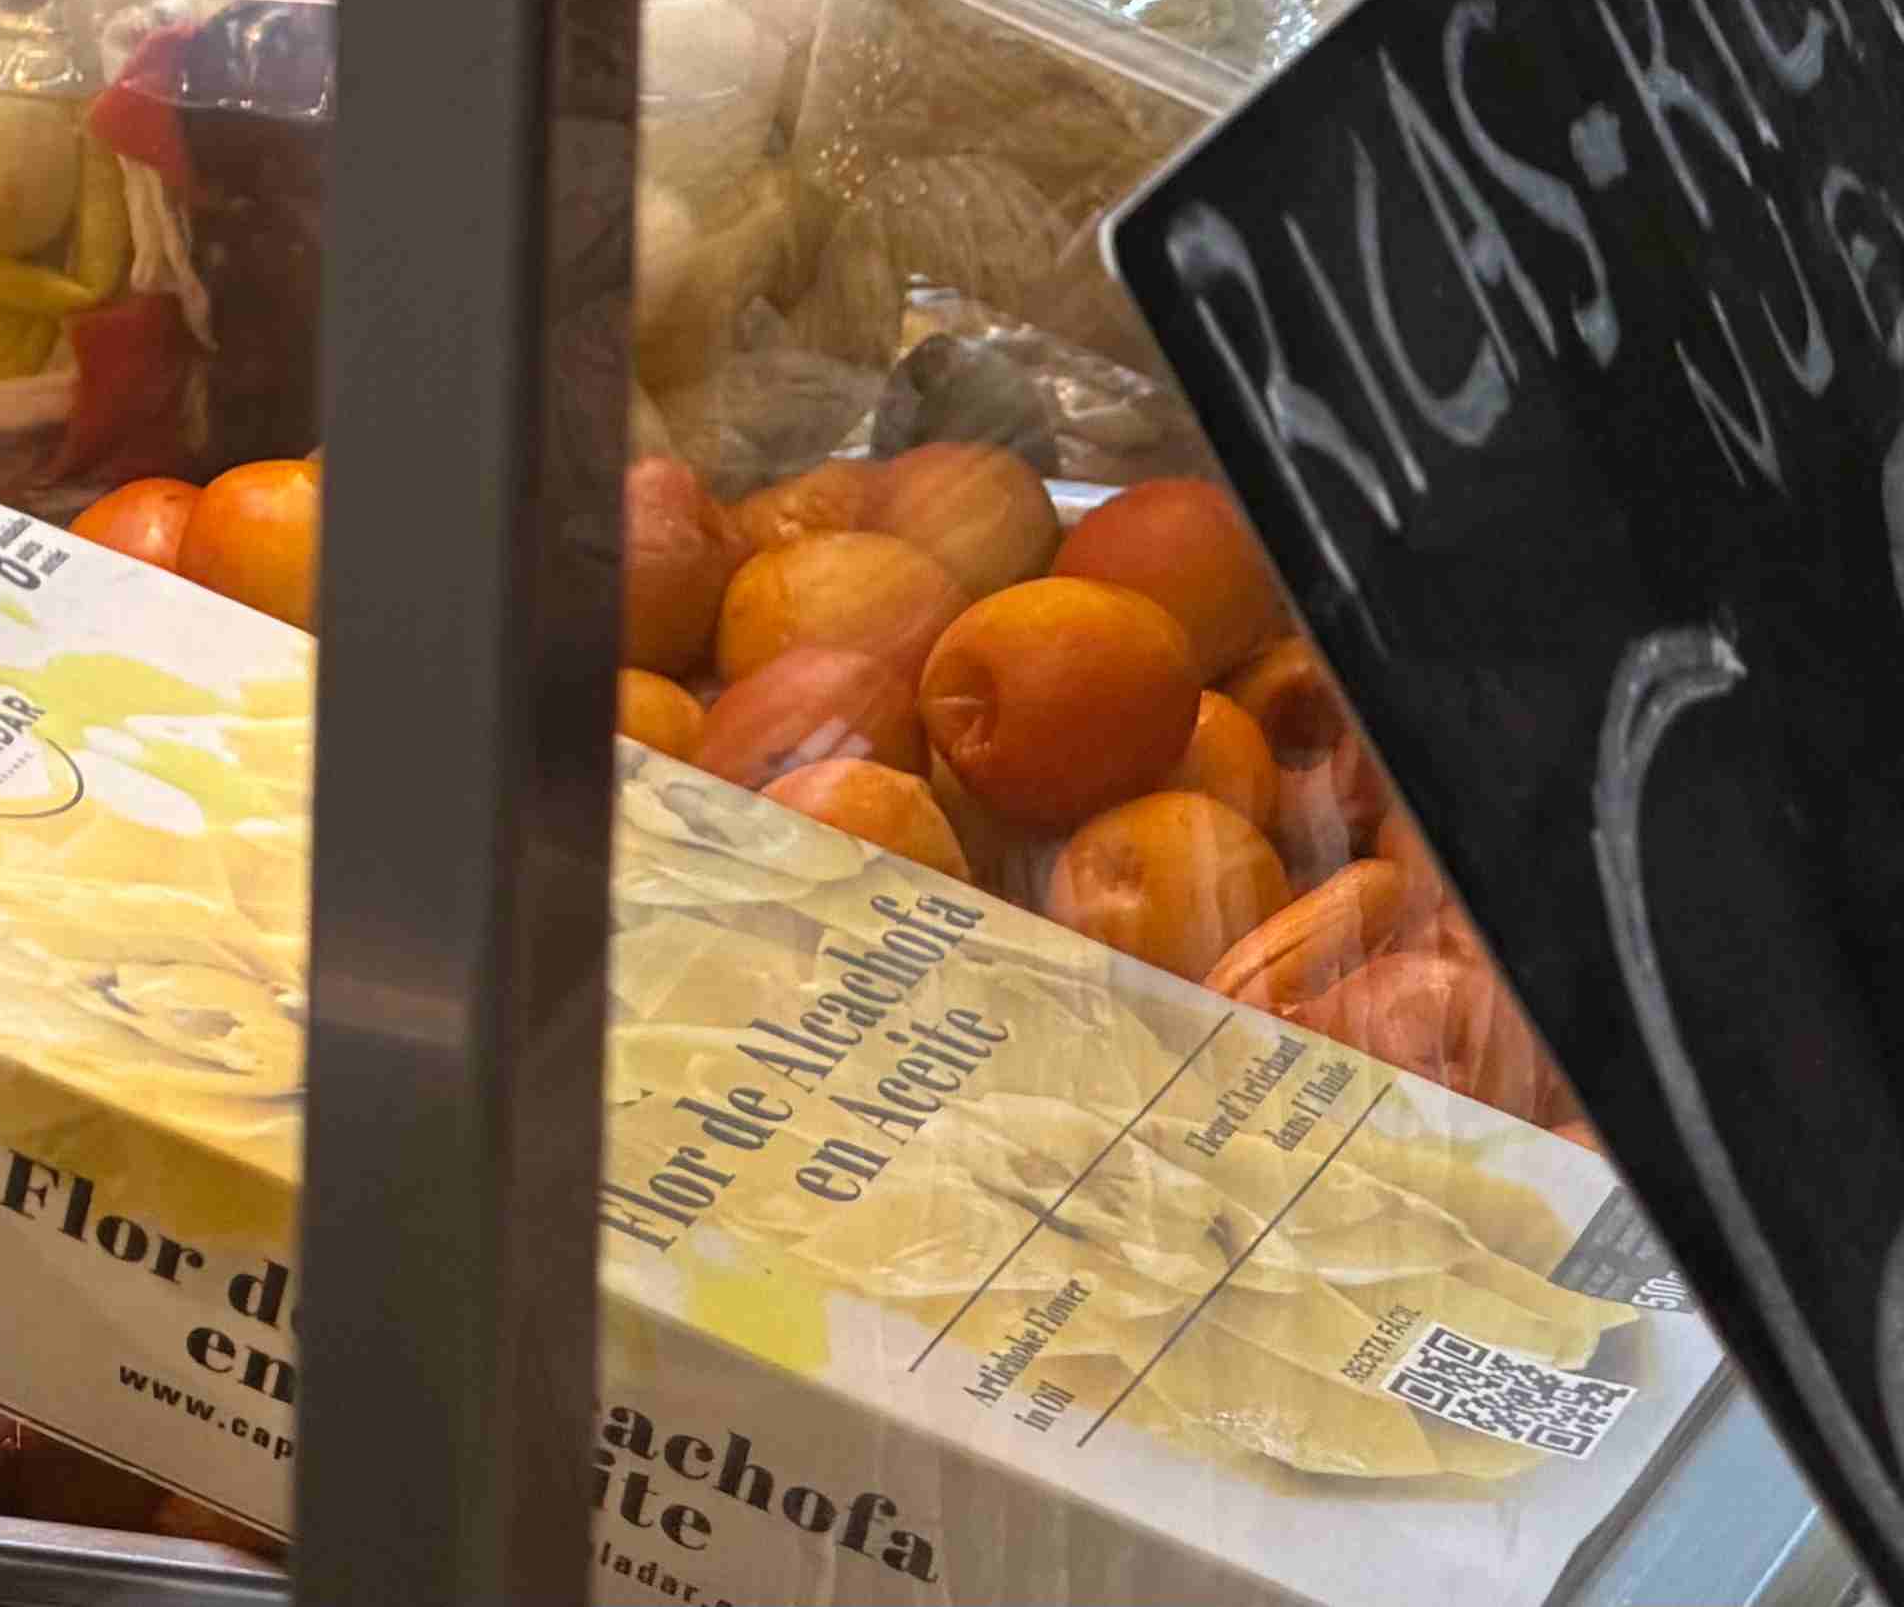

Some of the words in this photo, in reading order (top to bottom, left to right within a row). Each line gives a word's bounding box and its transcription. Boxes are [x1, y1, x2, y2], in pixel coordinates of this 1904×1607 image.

[599, 1146, 737, 1253] Flor
[674, 1087, 793, 1152] de
[735, 893, 985, 1094] Alcachofa
[828, 1007, 1009, 1146] Aceite
[794, 1137, 892, 1203] en
[962, 1329, 1050, 1409] Artichoke
[1023, 1278, 1092, 1336] Flower
[1030, 1378, 1077, 1413] Oil
[118, 1363, 295, 1462] www.cap
[226, 1256, 301, 1332] d
[592, 1400, 939, 1585] achofa
[1013, 1409, 1057, 1433] in
[592, 1447, 712, 1552] ite
